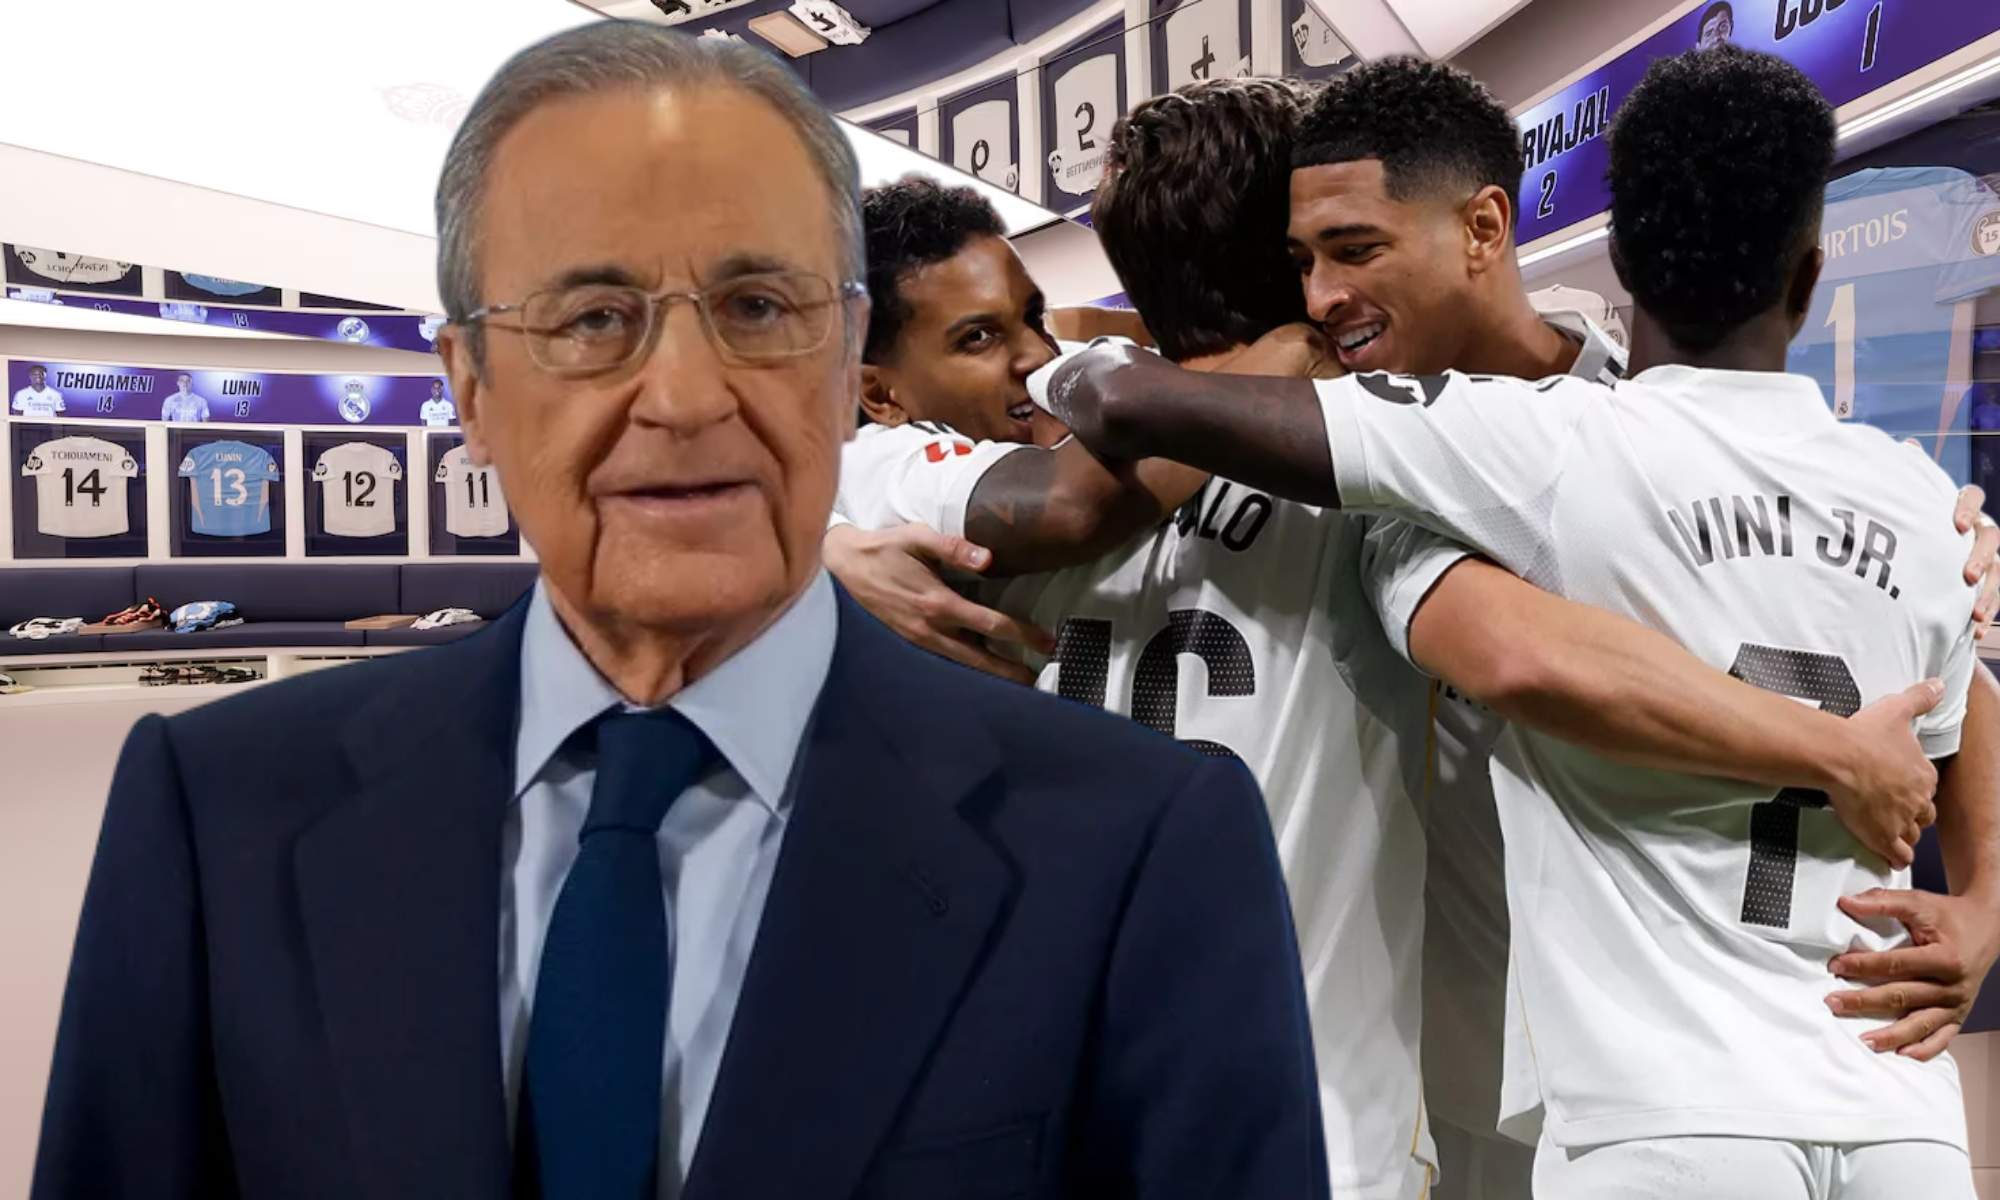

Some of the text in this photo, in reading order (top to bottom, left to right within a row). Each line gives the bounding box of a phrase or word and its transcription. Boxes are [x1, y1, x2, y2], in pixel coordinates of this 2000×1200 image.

[1860, 0, 1882, 72] 1
[1537, 169, 1558, 219] 2
[1823, 282, 1856, 419] 1
[56, 370, 154, 393] TCHOUAMENI
[222, 379, 262, 397] LUNIN
[97, 394, 114, 412] 14
[235, 400, 250, 416] 13
[61, 467, 108, 507] 14
[210, 467, 248, 506] 13
[342, 470, 376, 507] 12
[465, 471, 489, 508] 11
[1667, 494, 1901, 600] VINI JR.
[1054, 608, 1256, 757] 16
[1727, 642, 1862, 929] 7
